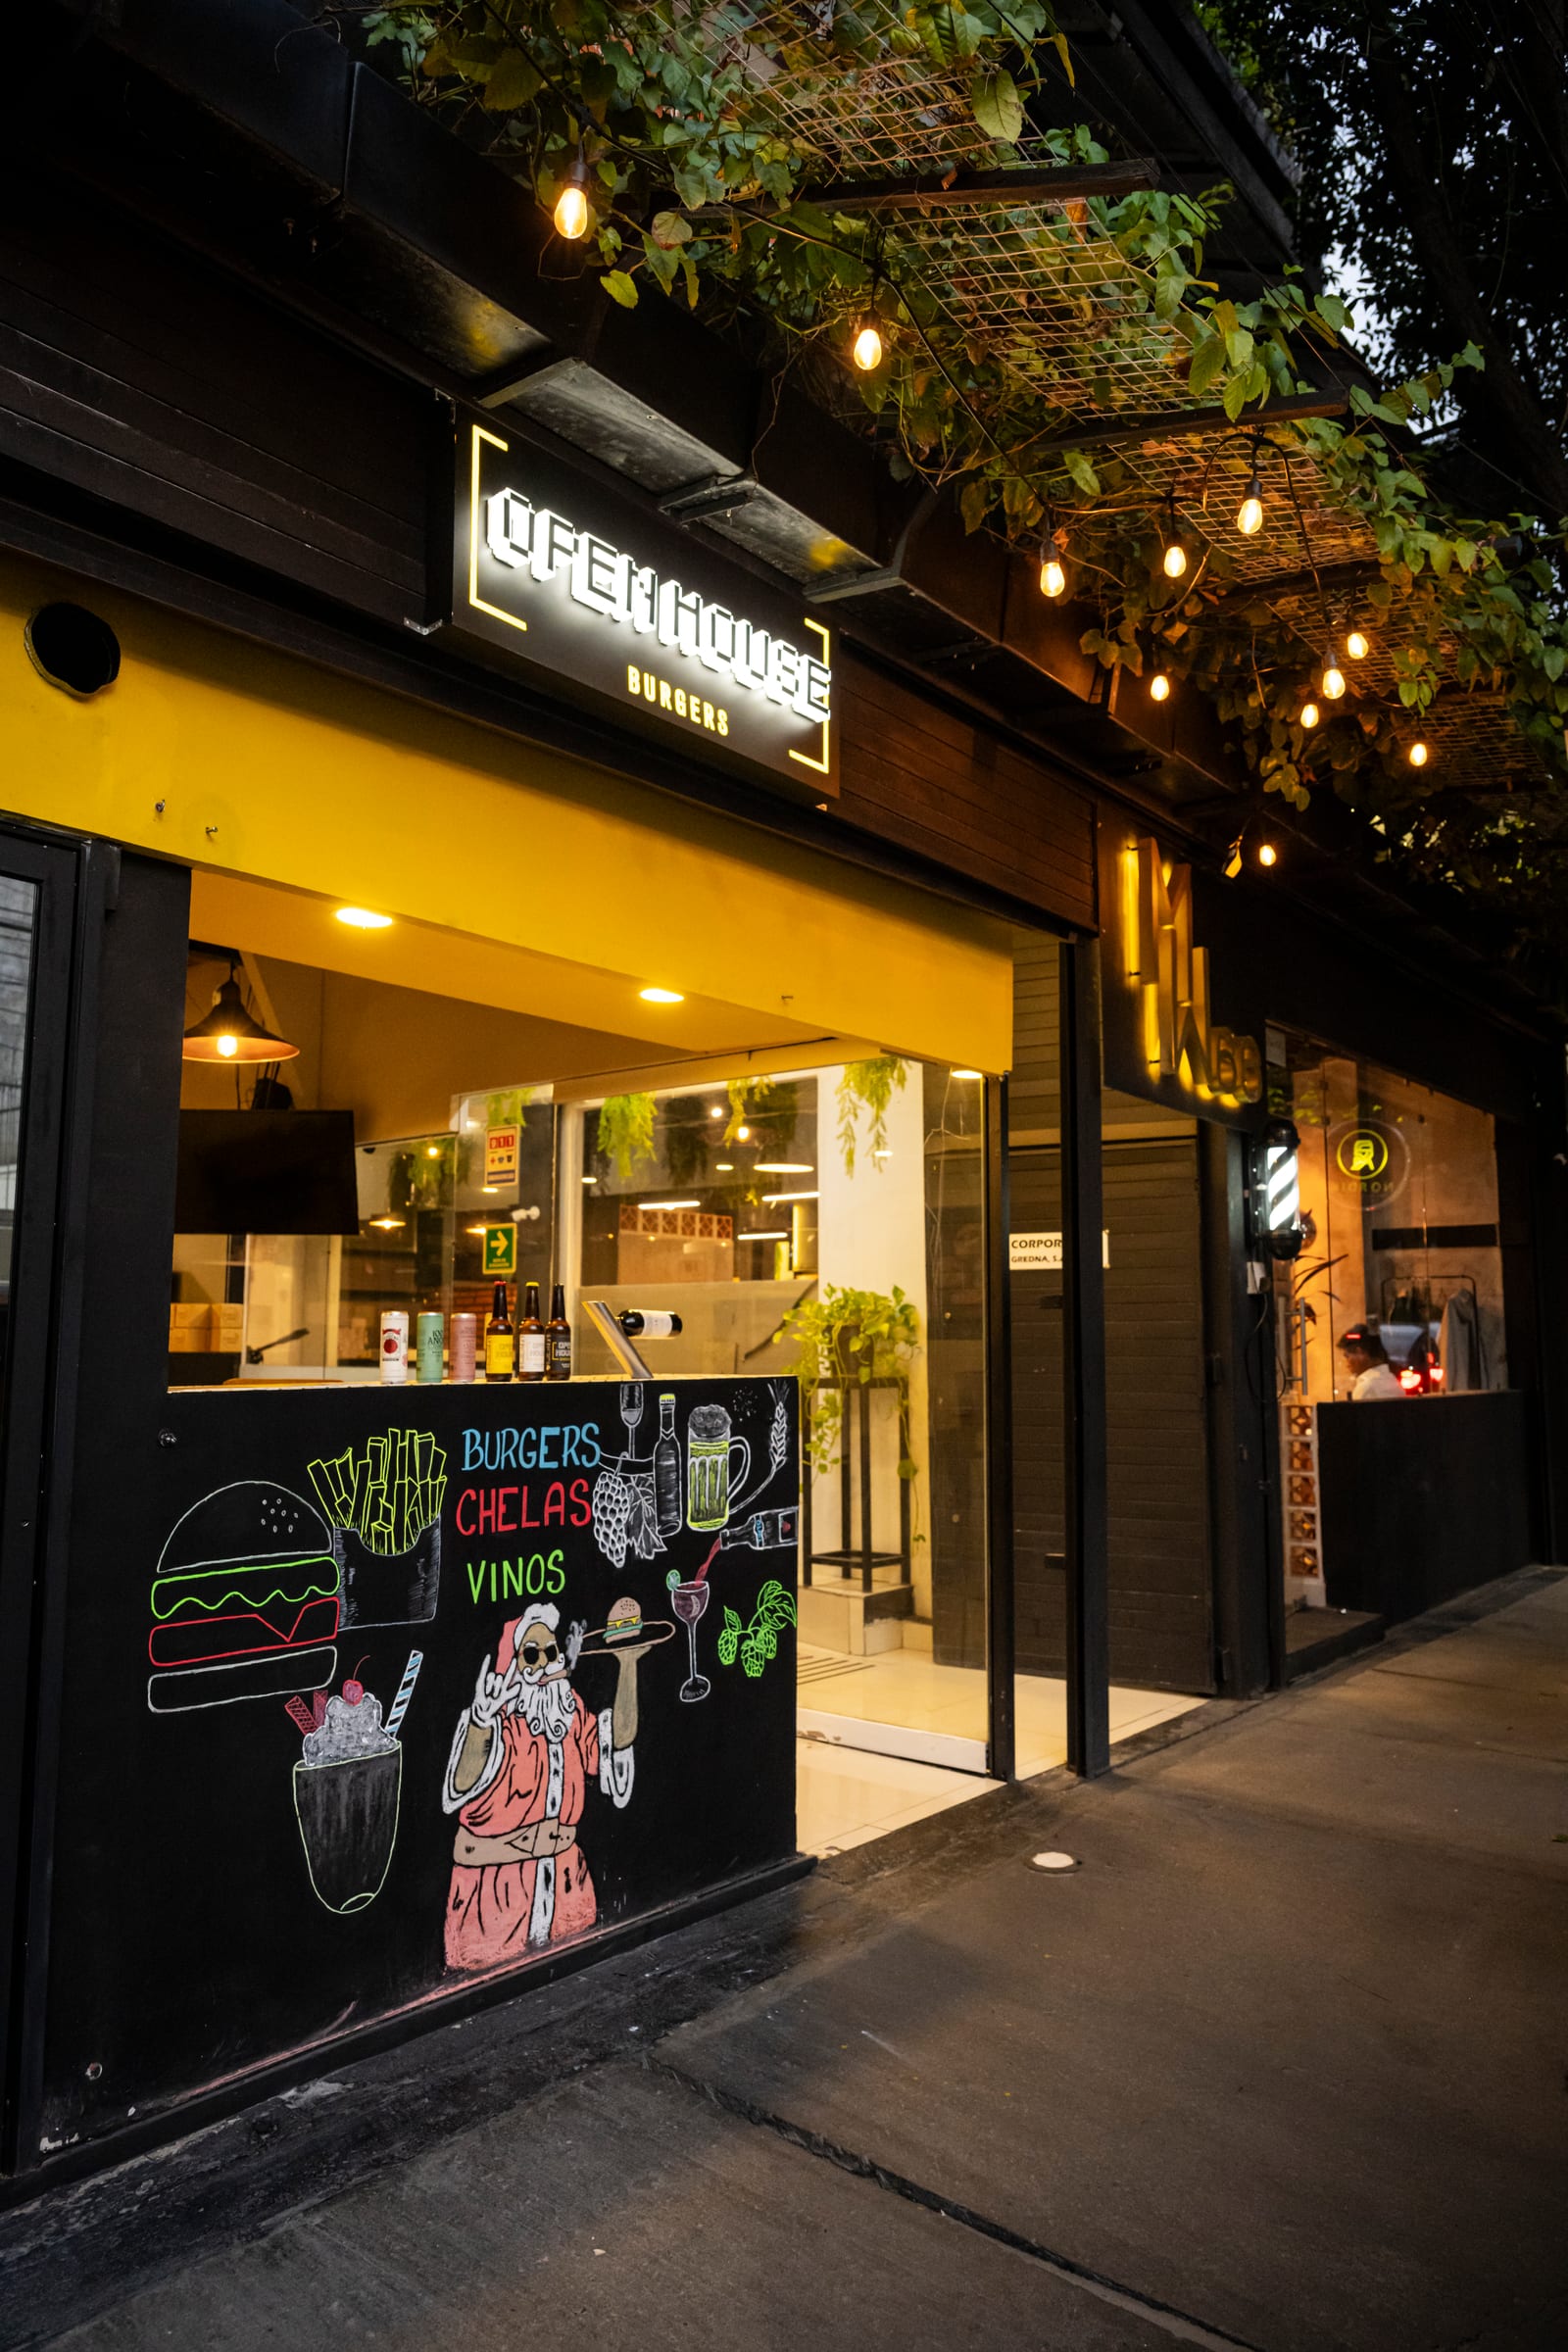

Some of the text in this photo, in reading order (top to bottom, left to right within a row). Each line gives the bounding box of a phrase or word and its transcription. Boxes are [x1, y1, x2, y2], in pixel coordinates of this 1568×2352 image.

[627, 664, 729, 737] BURGERS
[462, 1422, 601, 1470] BURGERS
[456, 1478, 592, 1536] CHELAS
[466, 1548, 565, 1604] VINOS
